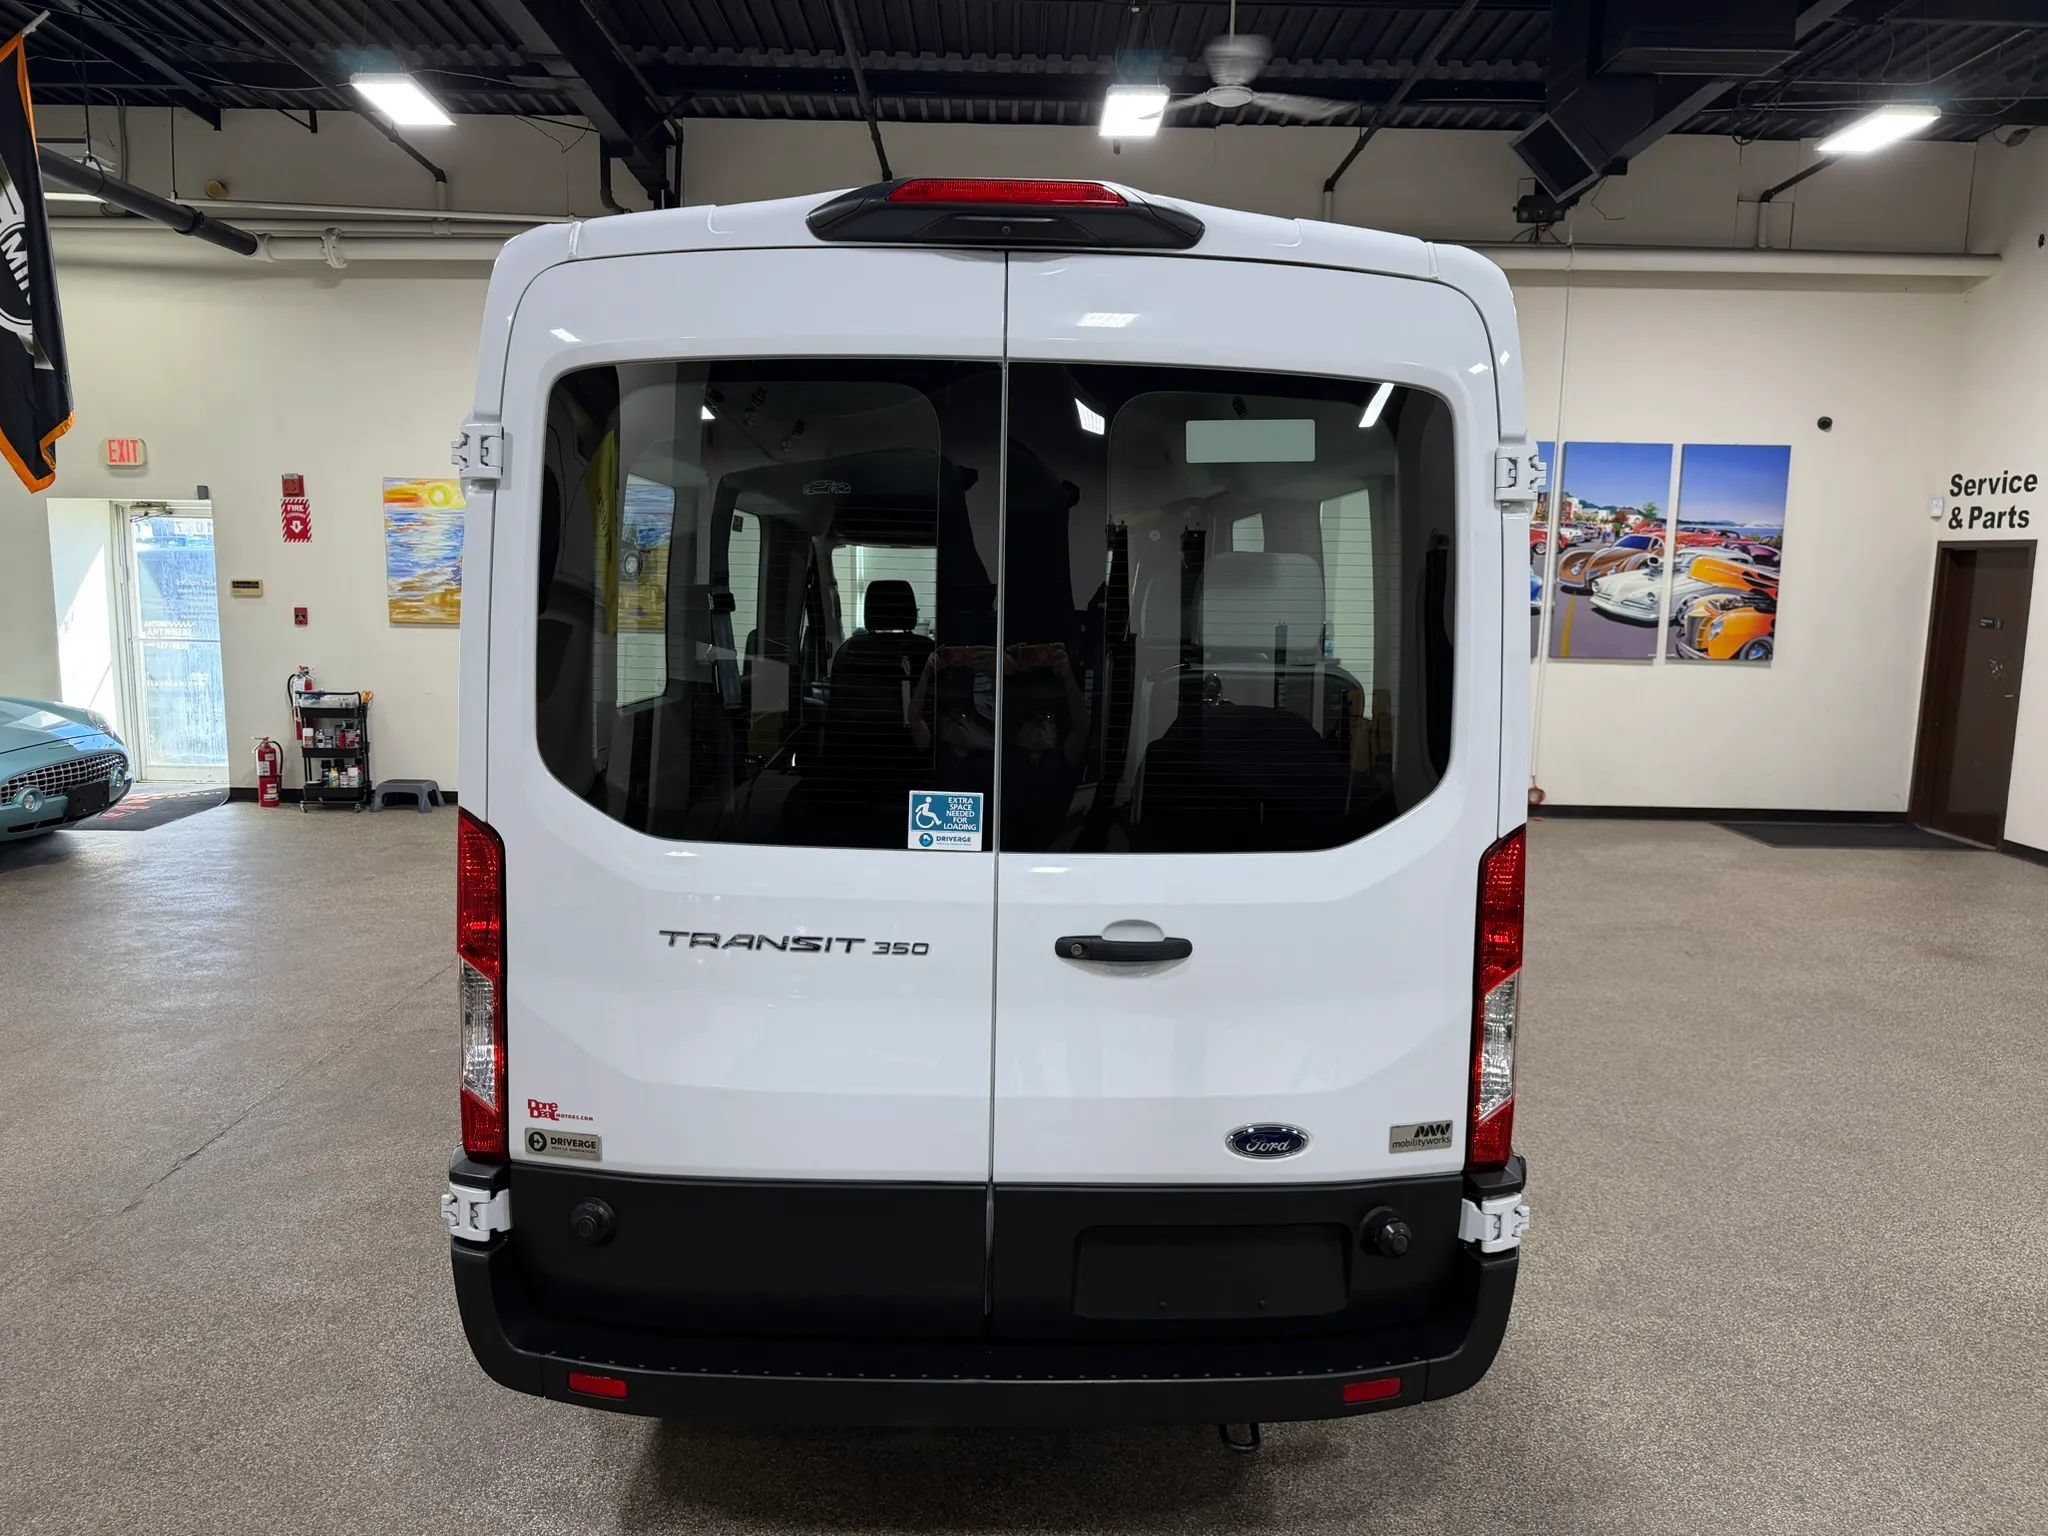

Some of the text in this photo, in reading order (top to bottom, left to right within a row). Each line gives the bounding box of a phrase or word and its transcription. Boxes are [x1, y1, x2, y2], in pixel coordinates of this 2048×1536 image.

[108, 440, 139, 464] EXIT
[1949, 470, 2038, 497] Service
[287, 504, 305, 512] FIRE
[1948, 504, 2030, 530] & Parts
[943, 823, 976, 831] LOADING
[659, 930, 930, 956] TRANSIT 350
[528, 1099, 558, 1111] Done
[556, 1113, 594, 1121] MOTORS.COM
[550, 1137, 597, 1149] DRIVERGE
[1245, 1132, 1291, 1153] Ford
[1392, 1136, 1452, 1152] mobilityworks
